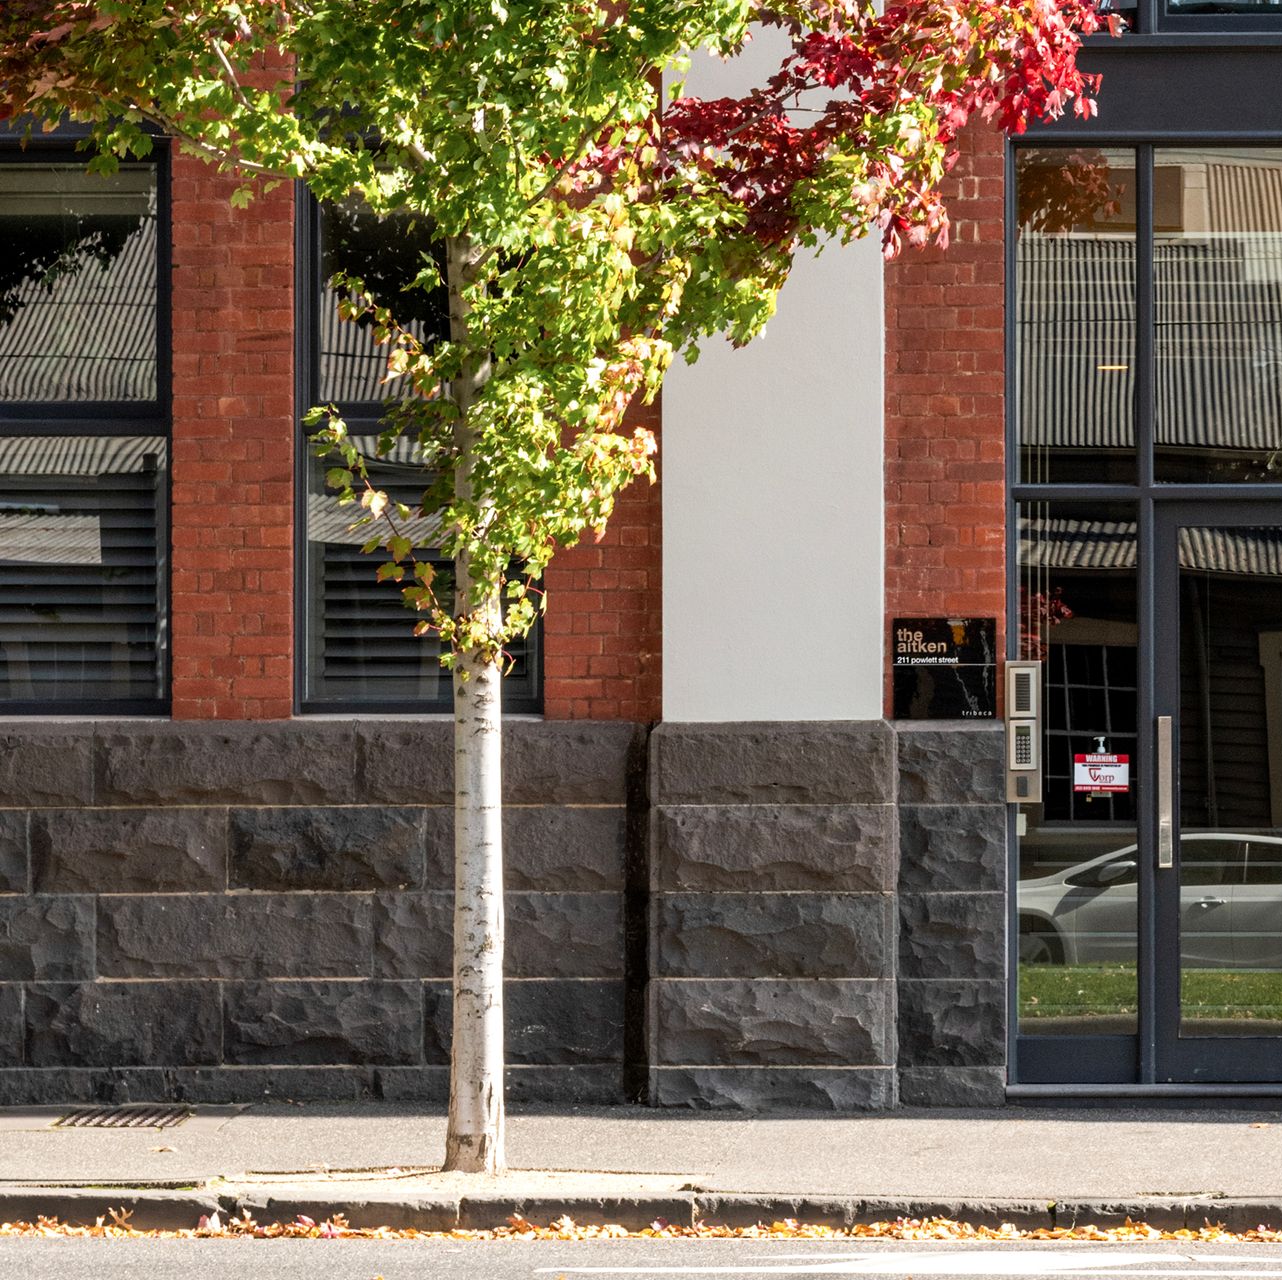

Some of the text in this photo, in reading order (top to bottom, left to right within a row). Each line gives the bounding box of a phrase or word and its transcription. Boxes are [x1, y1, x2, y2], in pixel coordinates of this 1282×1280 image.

[896, 628, 923, 641] the
[897, 639, 947, 653] aitken
[897, 656, 959, 665] 211 powlett street
[1086, 754, 1118, 763] WARNING
